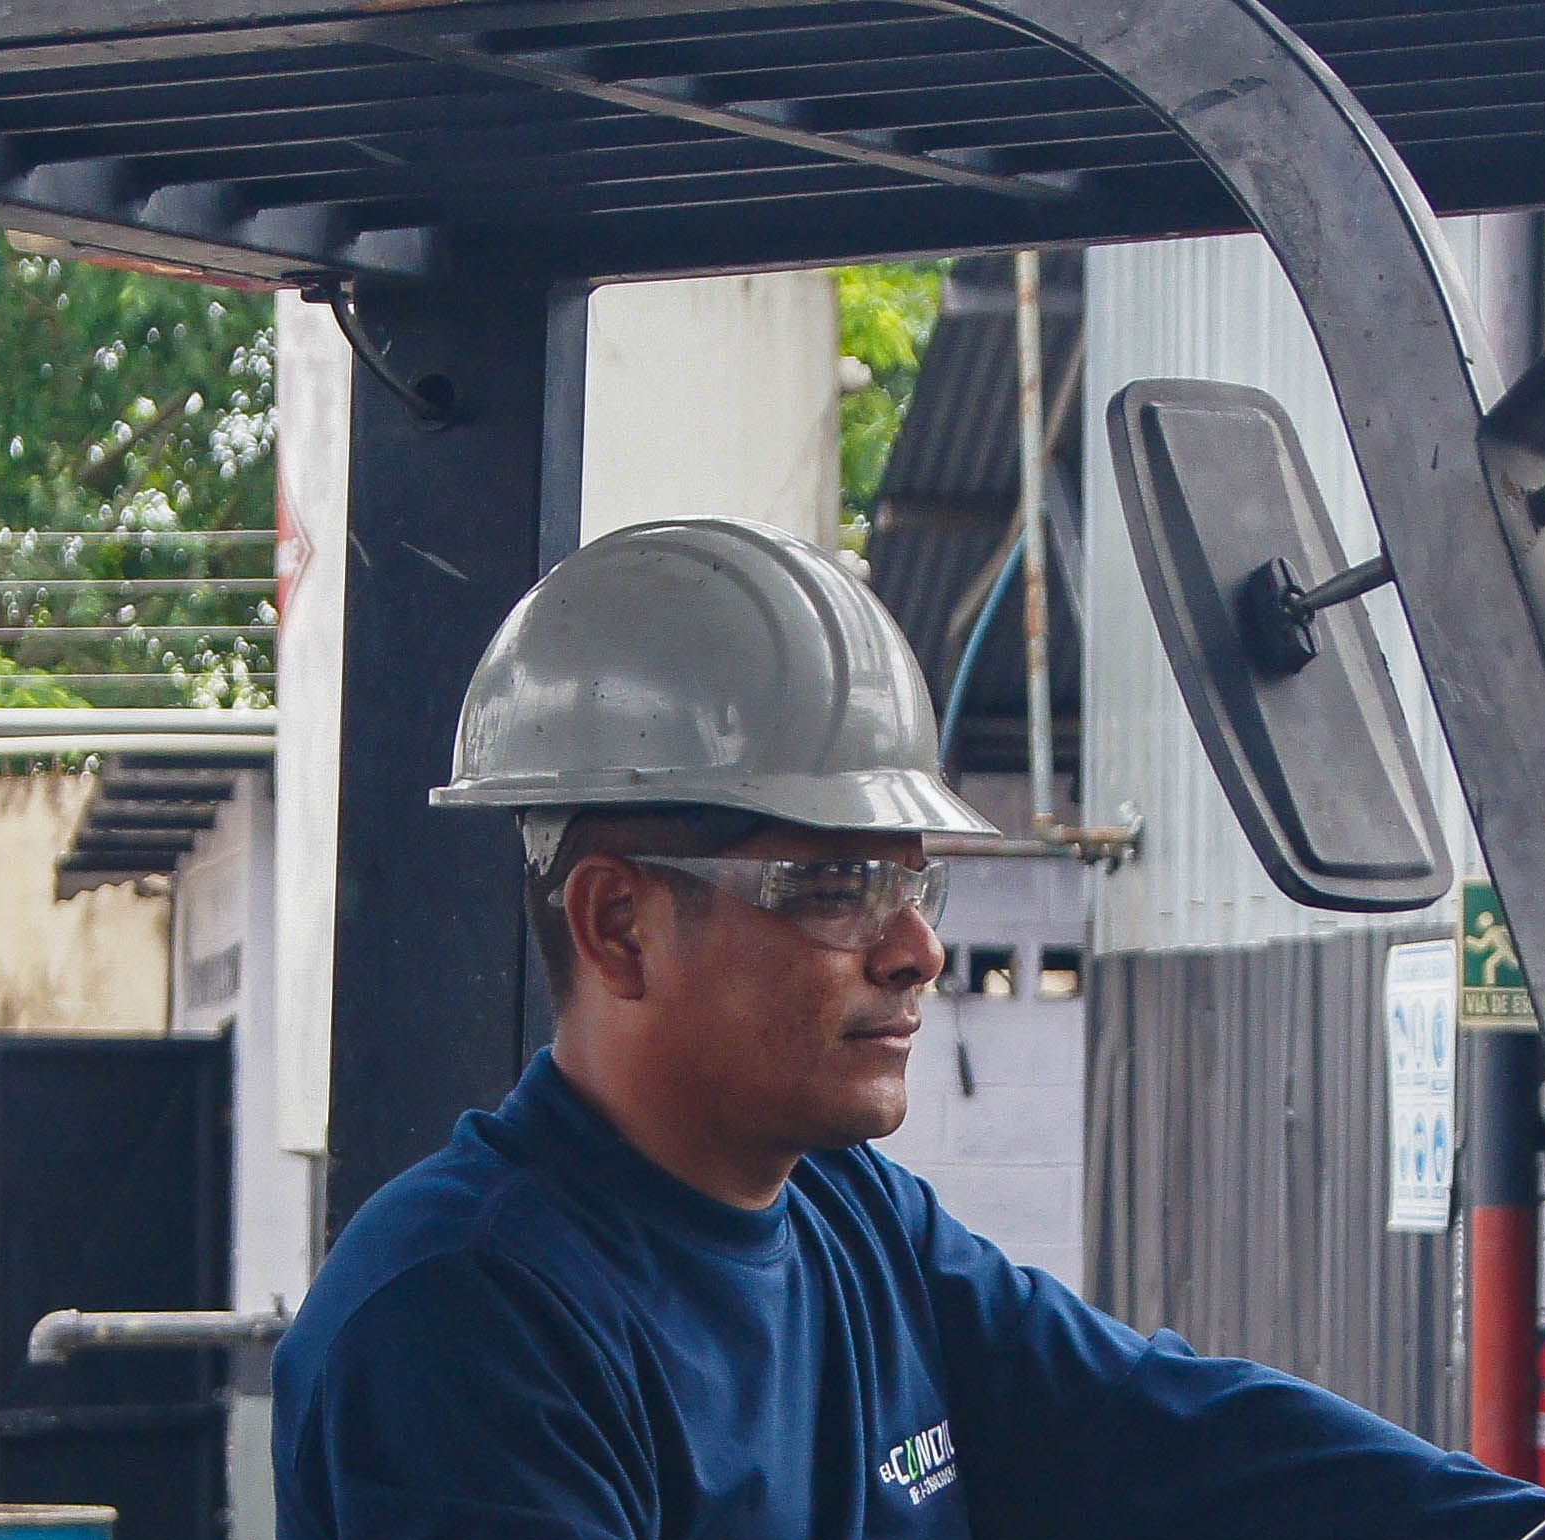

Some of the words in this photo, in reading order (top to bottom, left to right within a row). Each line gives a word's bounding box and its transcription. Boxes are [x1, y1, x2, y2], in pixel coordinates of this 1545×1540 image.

[1465, 992, 1488, 1014] VIA
[1491, 992, 1508, 1014] DE
[879, 1461, 896, 1484] EL
